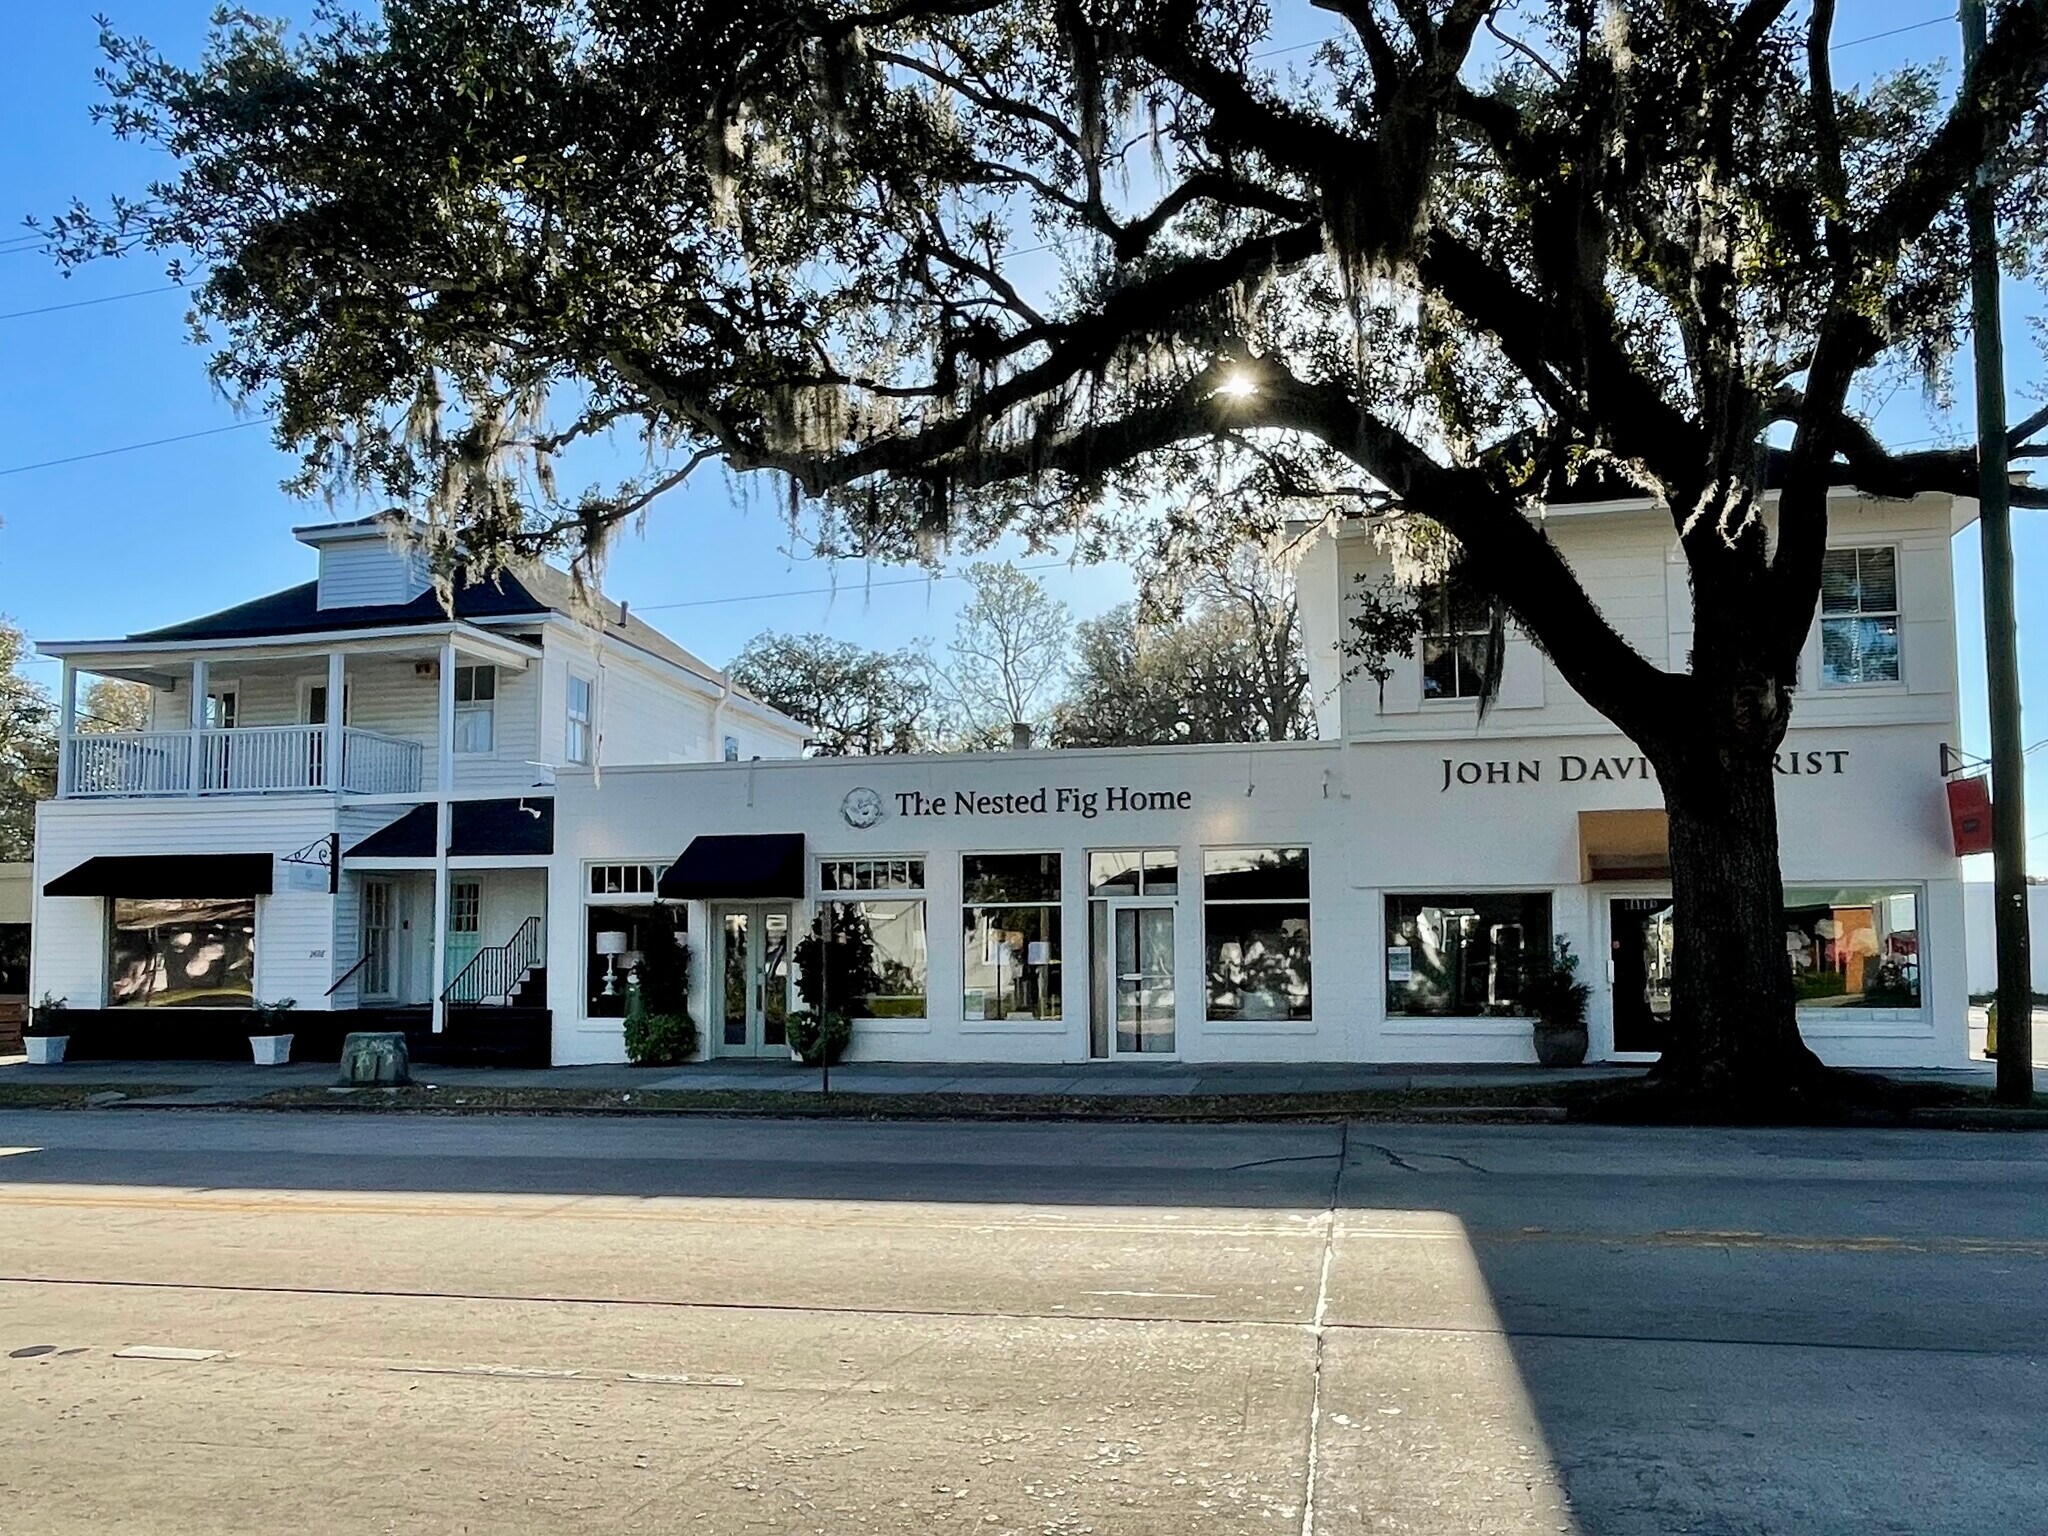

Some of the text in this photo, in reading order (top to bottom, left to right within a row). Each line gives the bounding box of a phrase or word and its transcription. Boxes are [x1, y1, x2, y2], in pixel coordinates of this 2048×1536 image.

[1441, 759, 1542, 793] JOHN
[1559, 755, 1649, 782] DAVI
[895, 787, 1192, 818] The Nested Fig Home
